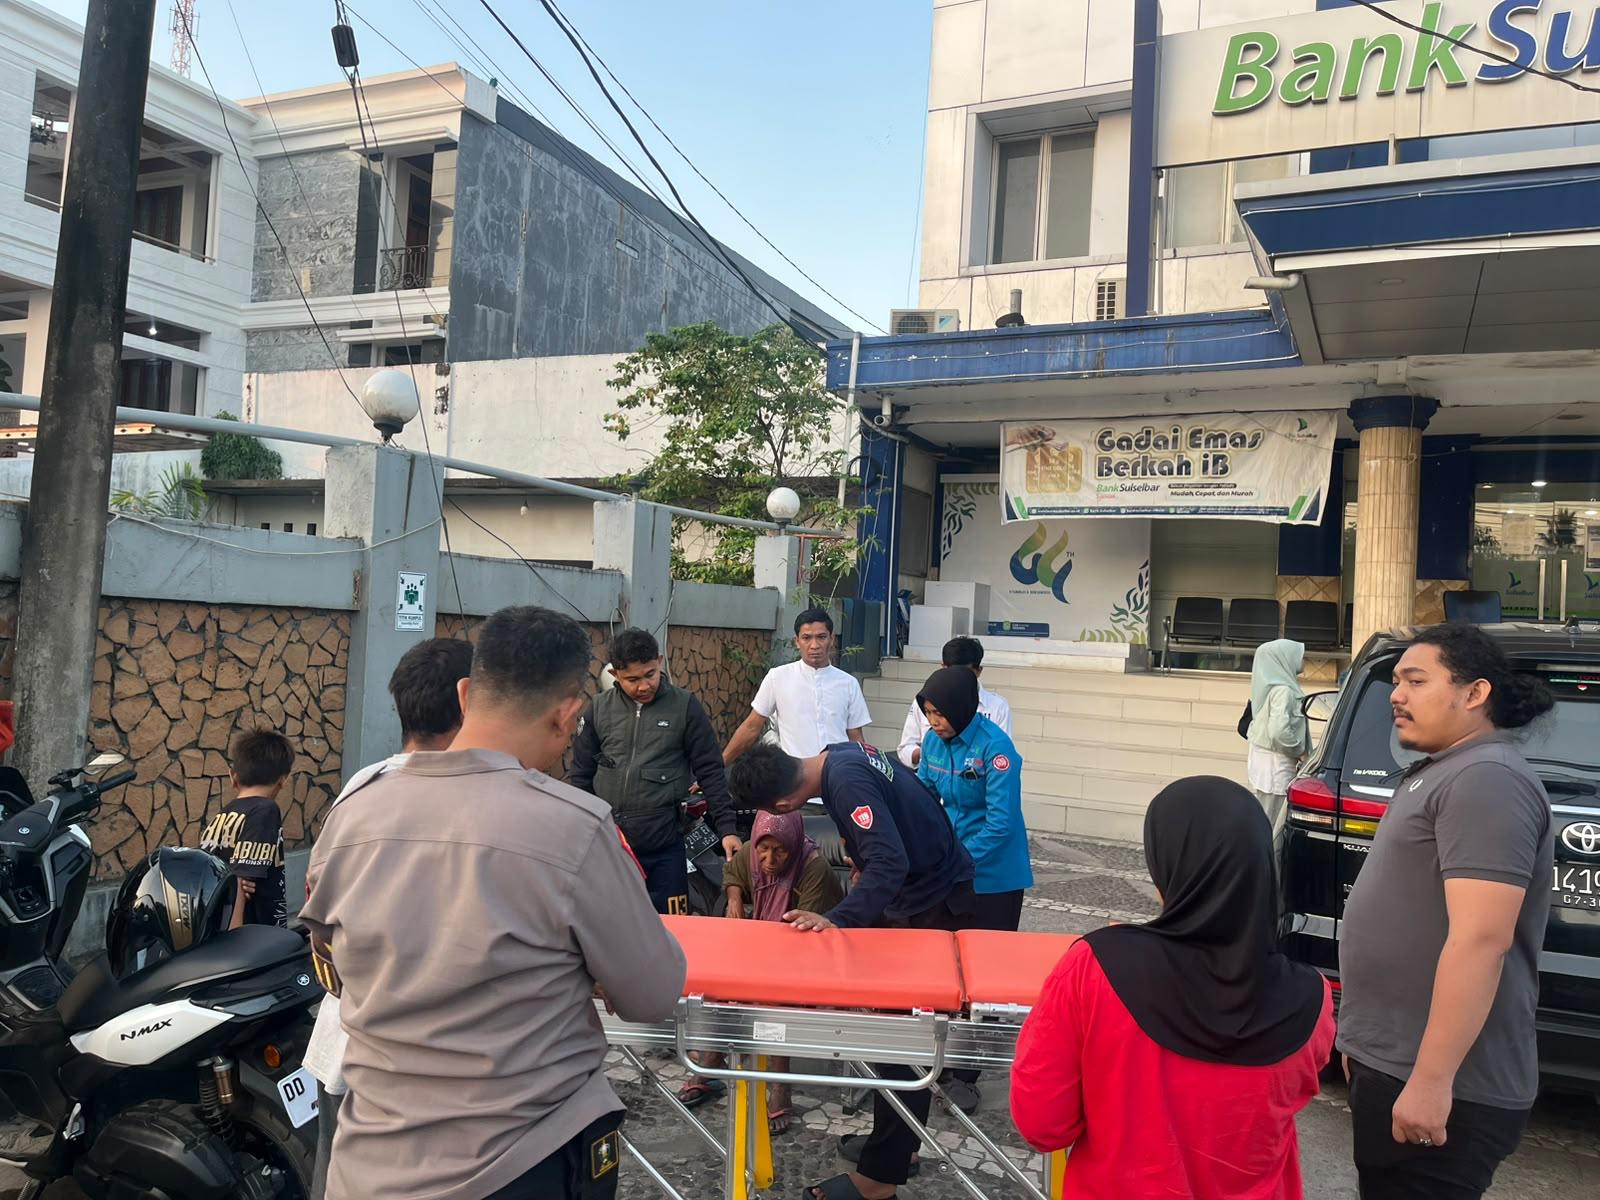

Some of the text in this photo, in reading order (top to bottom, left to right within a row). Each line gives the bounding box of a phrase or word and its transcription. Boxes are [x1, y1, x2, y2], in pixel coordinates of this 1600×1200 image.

[1097, 426, 1264, 451] Gadai Emas
[1097, 452, 1230, 477] Berkah iB
[1096, 483, 1161, 493] BankSulselbar
[283, 1077, 305, 1102] DD
